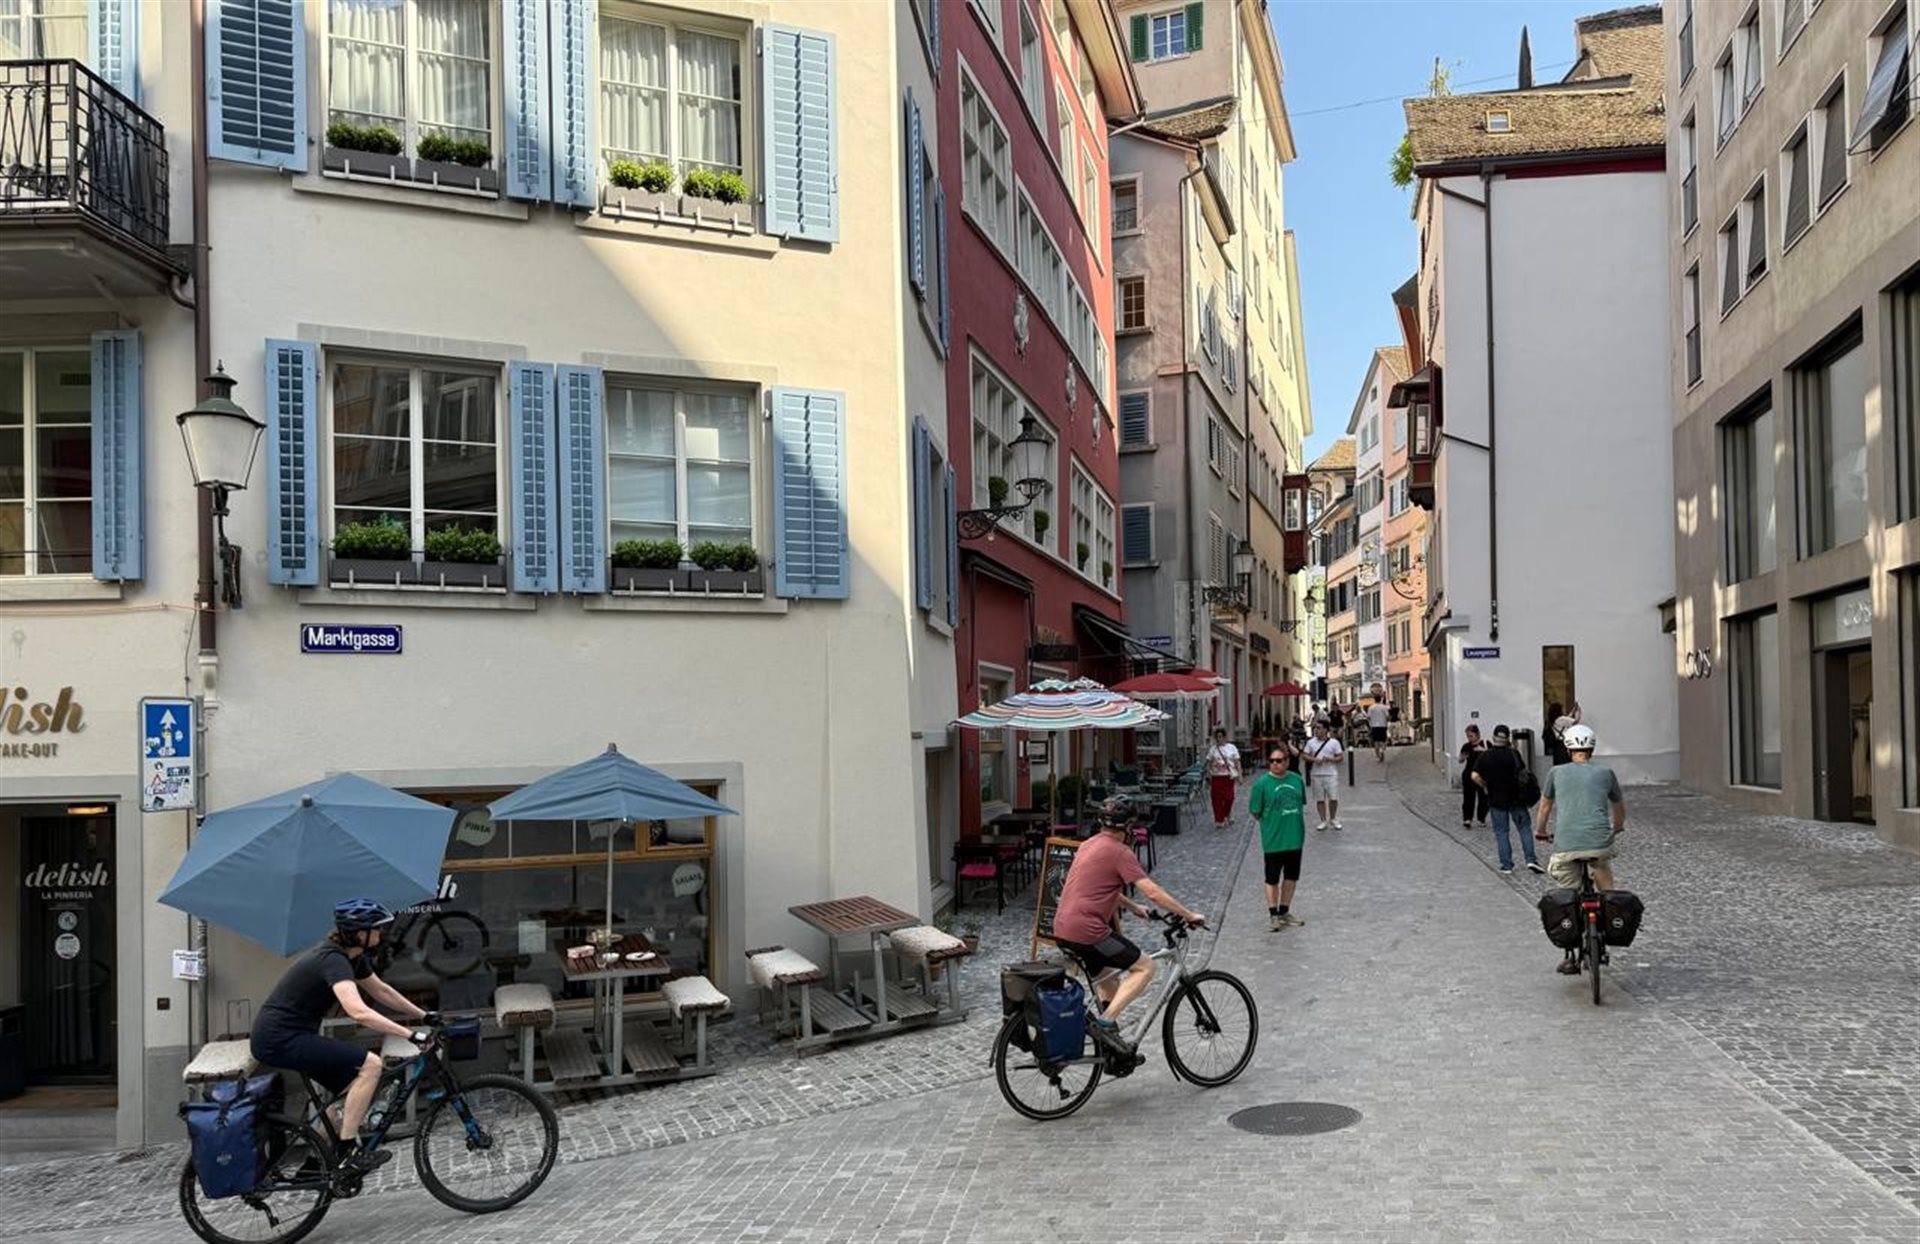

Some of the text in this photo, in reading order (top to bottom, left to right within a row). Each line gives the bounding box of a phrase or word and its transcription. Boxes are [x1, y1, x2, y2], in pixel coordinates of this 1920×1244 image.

[308, 627, 395, 650] Marktgasse
[1686, 648, 1711, 680] COS
[0, 686, 87, 735] ish
[0, 742, 59, 758] AKE-OUT
[25, 862, 110, 888] delish
[41, 891, 94, 900] LA PINSERIA
